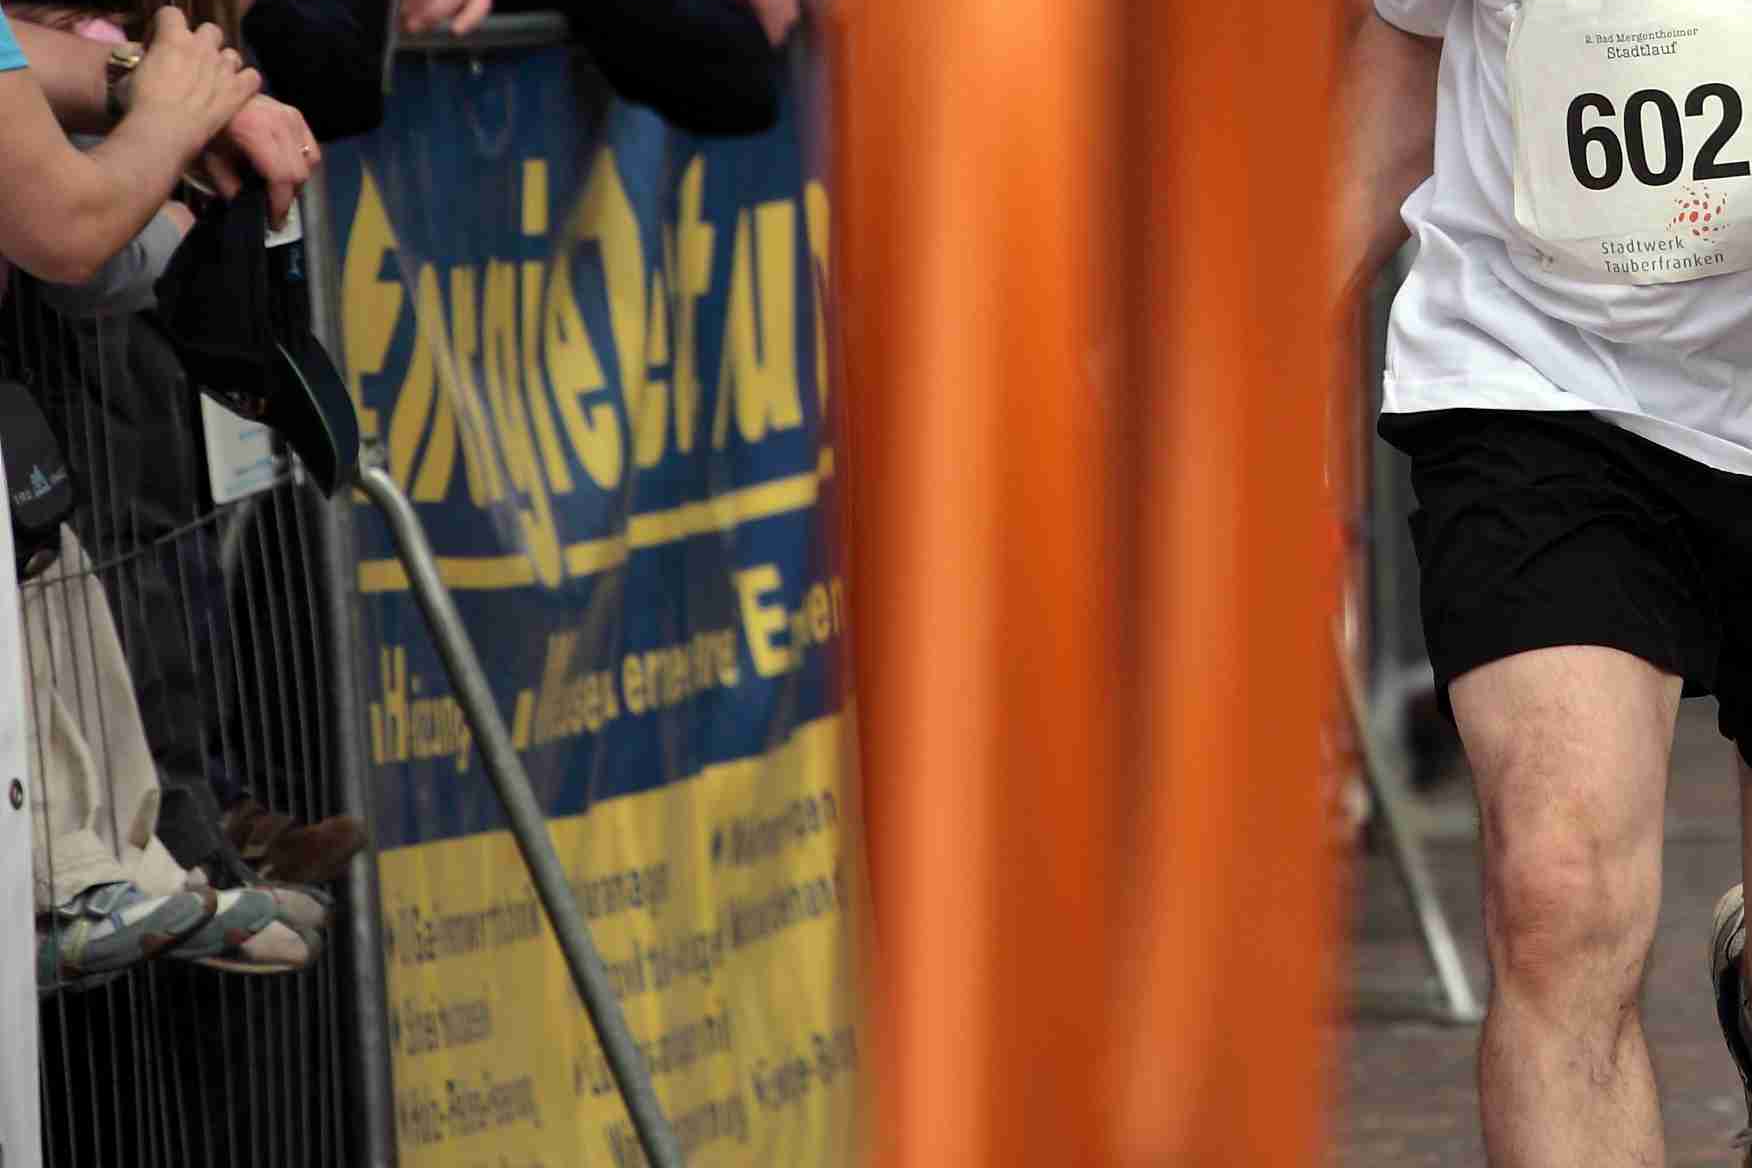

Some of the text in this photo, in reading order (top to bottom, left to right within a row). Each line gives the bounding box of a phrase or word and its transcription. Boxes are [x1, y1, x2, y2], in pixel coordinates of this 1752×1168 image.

[1596, 33, 1615, 44] Bad
[1616, 27, 1699, 43] Mergentheimer
[1607, 40, 1678, 59] Stadtlauf
[1566, 82, 1751, 191] 602
[1601, 235, 1686, 255] Stadtwerk
[1604, 251, 1725, 273] Tauberfranken
